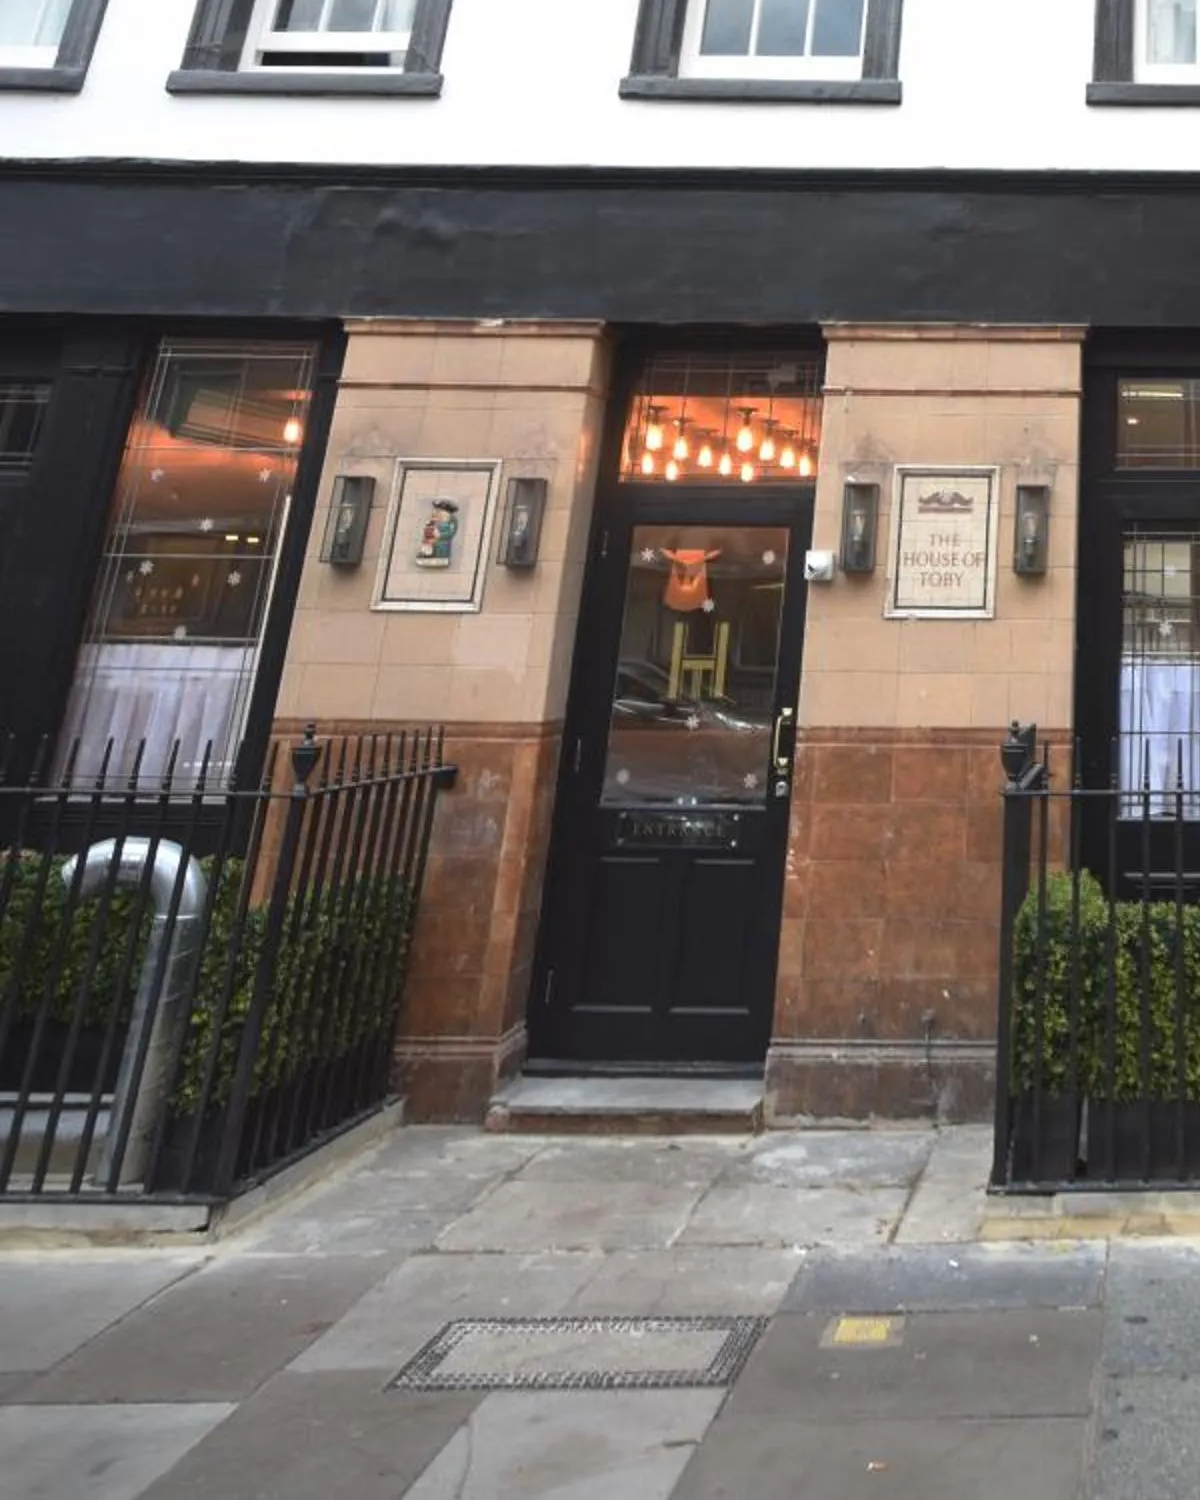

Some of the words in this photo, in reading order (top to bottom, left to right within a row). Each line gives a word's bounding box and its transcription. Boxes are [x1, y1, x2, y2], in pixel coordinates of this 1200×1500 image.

[928, 533, 961, 547] THE
[903, 551, 961, 567] HOUSE
[962, 551, 985, 568] OF
[920, 570, 964, 587] TOBY
[633, 822, 723, 837] ENTRACE
